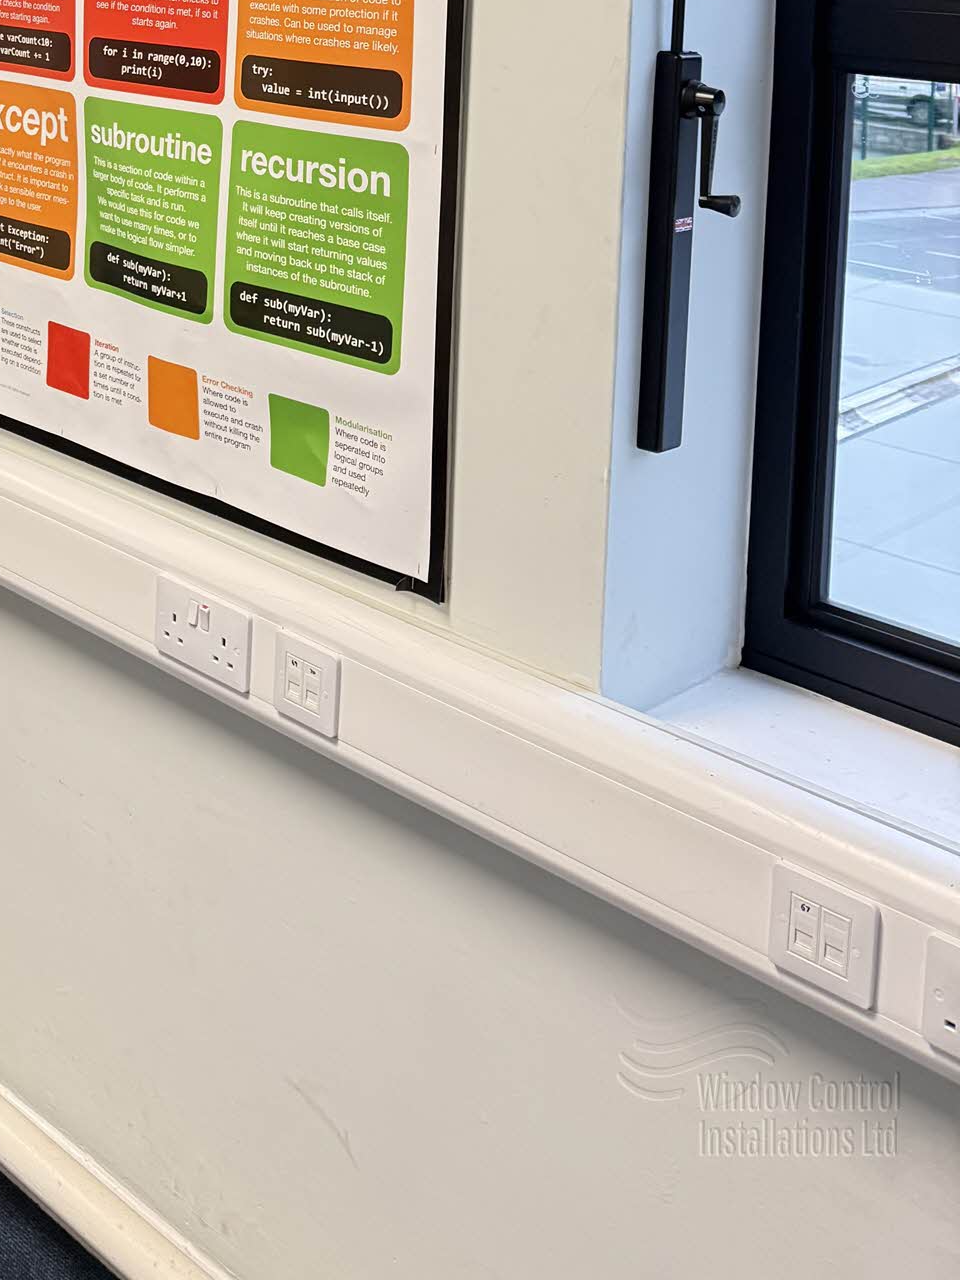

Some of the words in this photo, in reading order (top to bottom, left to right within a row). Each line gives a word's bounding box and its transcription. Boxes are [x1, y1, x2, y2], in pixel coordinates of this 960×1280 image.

[249, 1, 280, 11] execute
[281, 2, 299, 13] with
[301, 6, 326, 15] some
[329, 7, 379, 19] protection
[382, 9, 388, 20] if
[391, 10, 397, 21] it
[245, 28, 283, 41] situations
[284, 33, 311, 44] where
[312, 37, 350, 48] crashes
[352, 40, 369, 50] are
[371, 40, 398, 55] likely.
[249, 15, 281, 26] crashes.
[283, 17, 301, 28] Can
[303, 19, 315, 29] be
[317, 21, 340, 32] used
[343, 22, 353, 33] to
[355, 25, 397, 38] manage
[103, 46, 117, 56] for
[122, 48, 126, 57] i
[132, 49, 142, 59] in
[147, 52, 211, 69] range(0,10):
[121, 64, 162, 79] print(i)
[252, 63, 272, 77] try:
[261, 82, 289, 95] value
[308, 87, 388, 109] int(input())
[91, 122, 212, 165] subroutine
[241, 149, 391, 197] recursion
[236, 184, 252, 197] This
[253, 189, 260, 199] is
[261, 192, 267, 201] a
[269, 194, 317, 210] subroutine
[319, 201, 338, 214] that
[340, 207, 364, 218] calls
[366, 209, 392, 223] itself.
[242, 201, 248, 212] It
[249, 204, 263, 214] will
[264, 206, 286, 221] keep
[288, 213, 326, 229] creating
[328, 220, 369, 235] versions
[371, 226, 382, 237] of
[236, 230, 261, 243] where
[262, 235, 269, 245] it
[270, 238, 285, 248] will
[287, 241, 308, 253] start
[311, 246, 353, 265] returning
[356, 256, 387, 269] values
[238, 215, 257, 228] itself
[259, 222, 277, 232] until
[279, 223, 286, 234] it
[287, 227, 325, 241] reaches
[327, 235, 333, 243] a
[336, 234, 360, 248] base
[362, 241, 385, 254] case
[107, 252, 119, 264] def
[122, 259, 170, 281] sub(myVar):
[236, 245, 252, 256] and
[254, 250, 286, 266] moving
[289, 255, 312, 269] back
[314, 262, 327, 273] up
[329, 264, 344, 276] the
[346, 269, 373, 282] stack
[374, 274, 385, 285] of
[246, 260, 288, 279] instances
[290, 271, 300, 281] of
[302, 273, 317, 285] the
[319, 278, 371, 297] subroutine.
[123, 274, 147, 290] return
[151, 284, 185, 301] myVar+1
[239, 290, 257, 303] def
[264, 298, 331, 322] sub(myVar):
[263, 314, 300, 331] return
[306, 325, 383, 356] sub(myVar-1)
[335, 416, 392, 441] Modularisation
